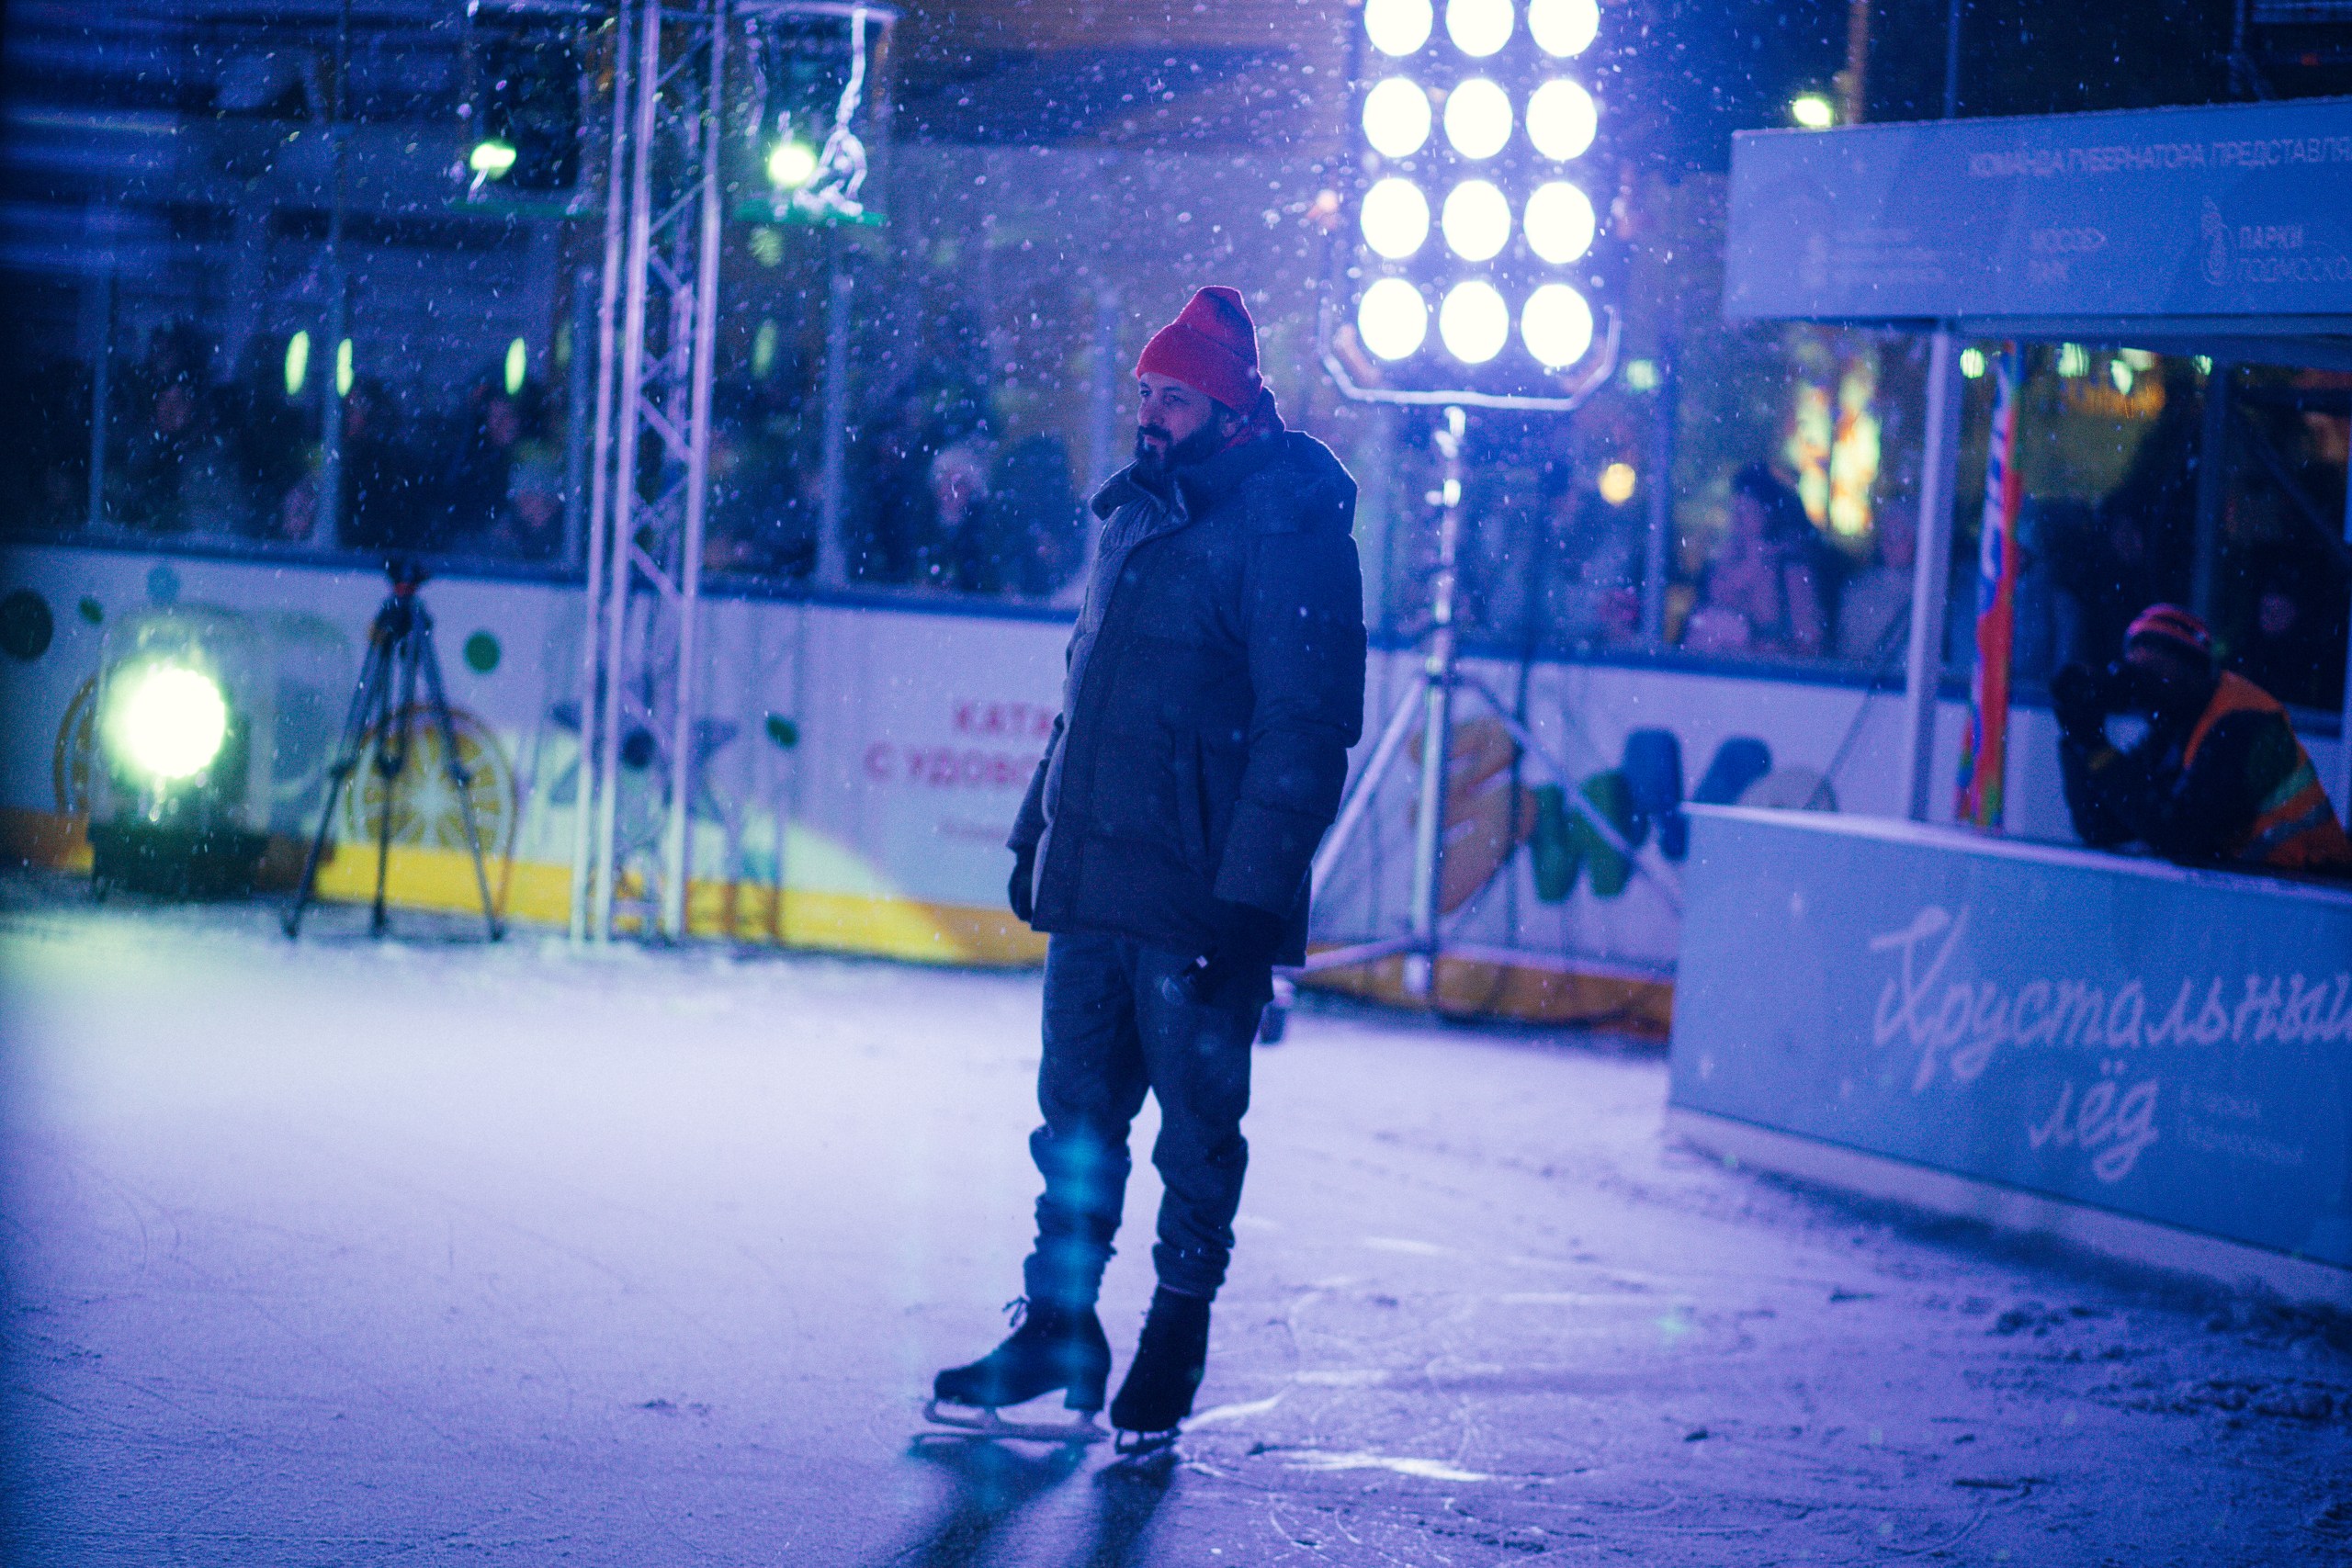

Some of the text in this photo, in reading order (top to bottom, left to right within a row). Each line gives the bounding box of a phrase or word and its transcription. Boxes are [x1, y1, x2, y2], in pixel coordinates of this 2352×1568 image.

[1969, 148, 2065, 177] КОМАНДА
[2069, 141, 2205, 172] ГУБЕРНАТОРА
[2239, 224, 2303, 250] ПАРКИ
[2237, 254, 2352, 283] ПОДМОСКО
[864, 739, 896, 781] С
[2027, 1057, 2159, 1183] лёд
